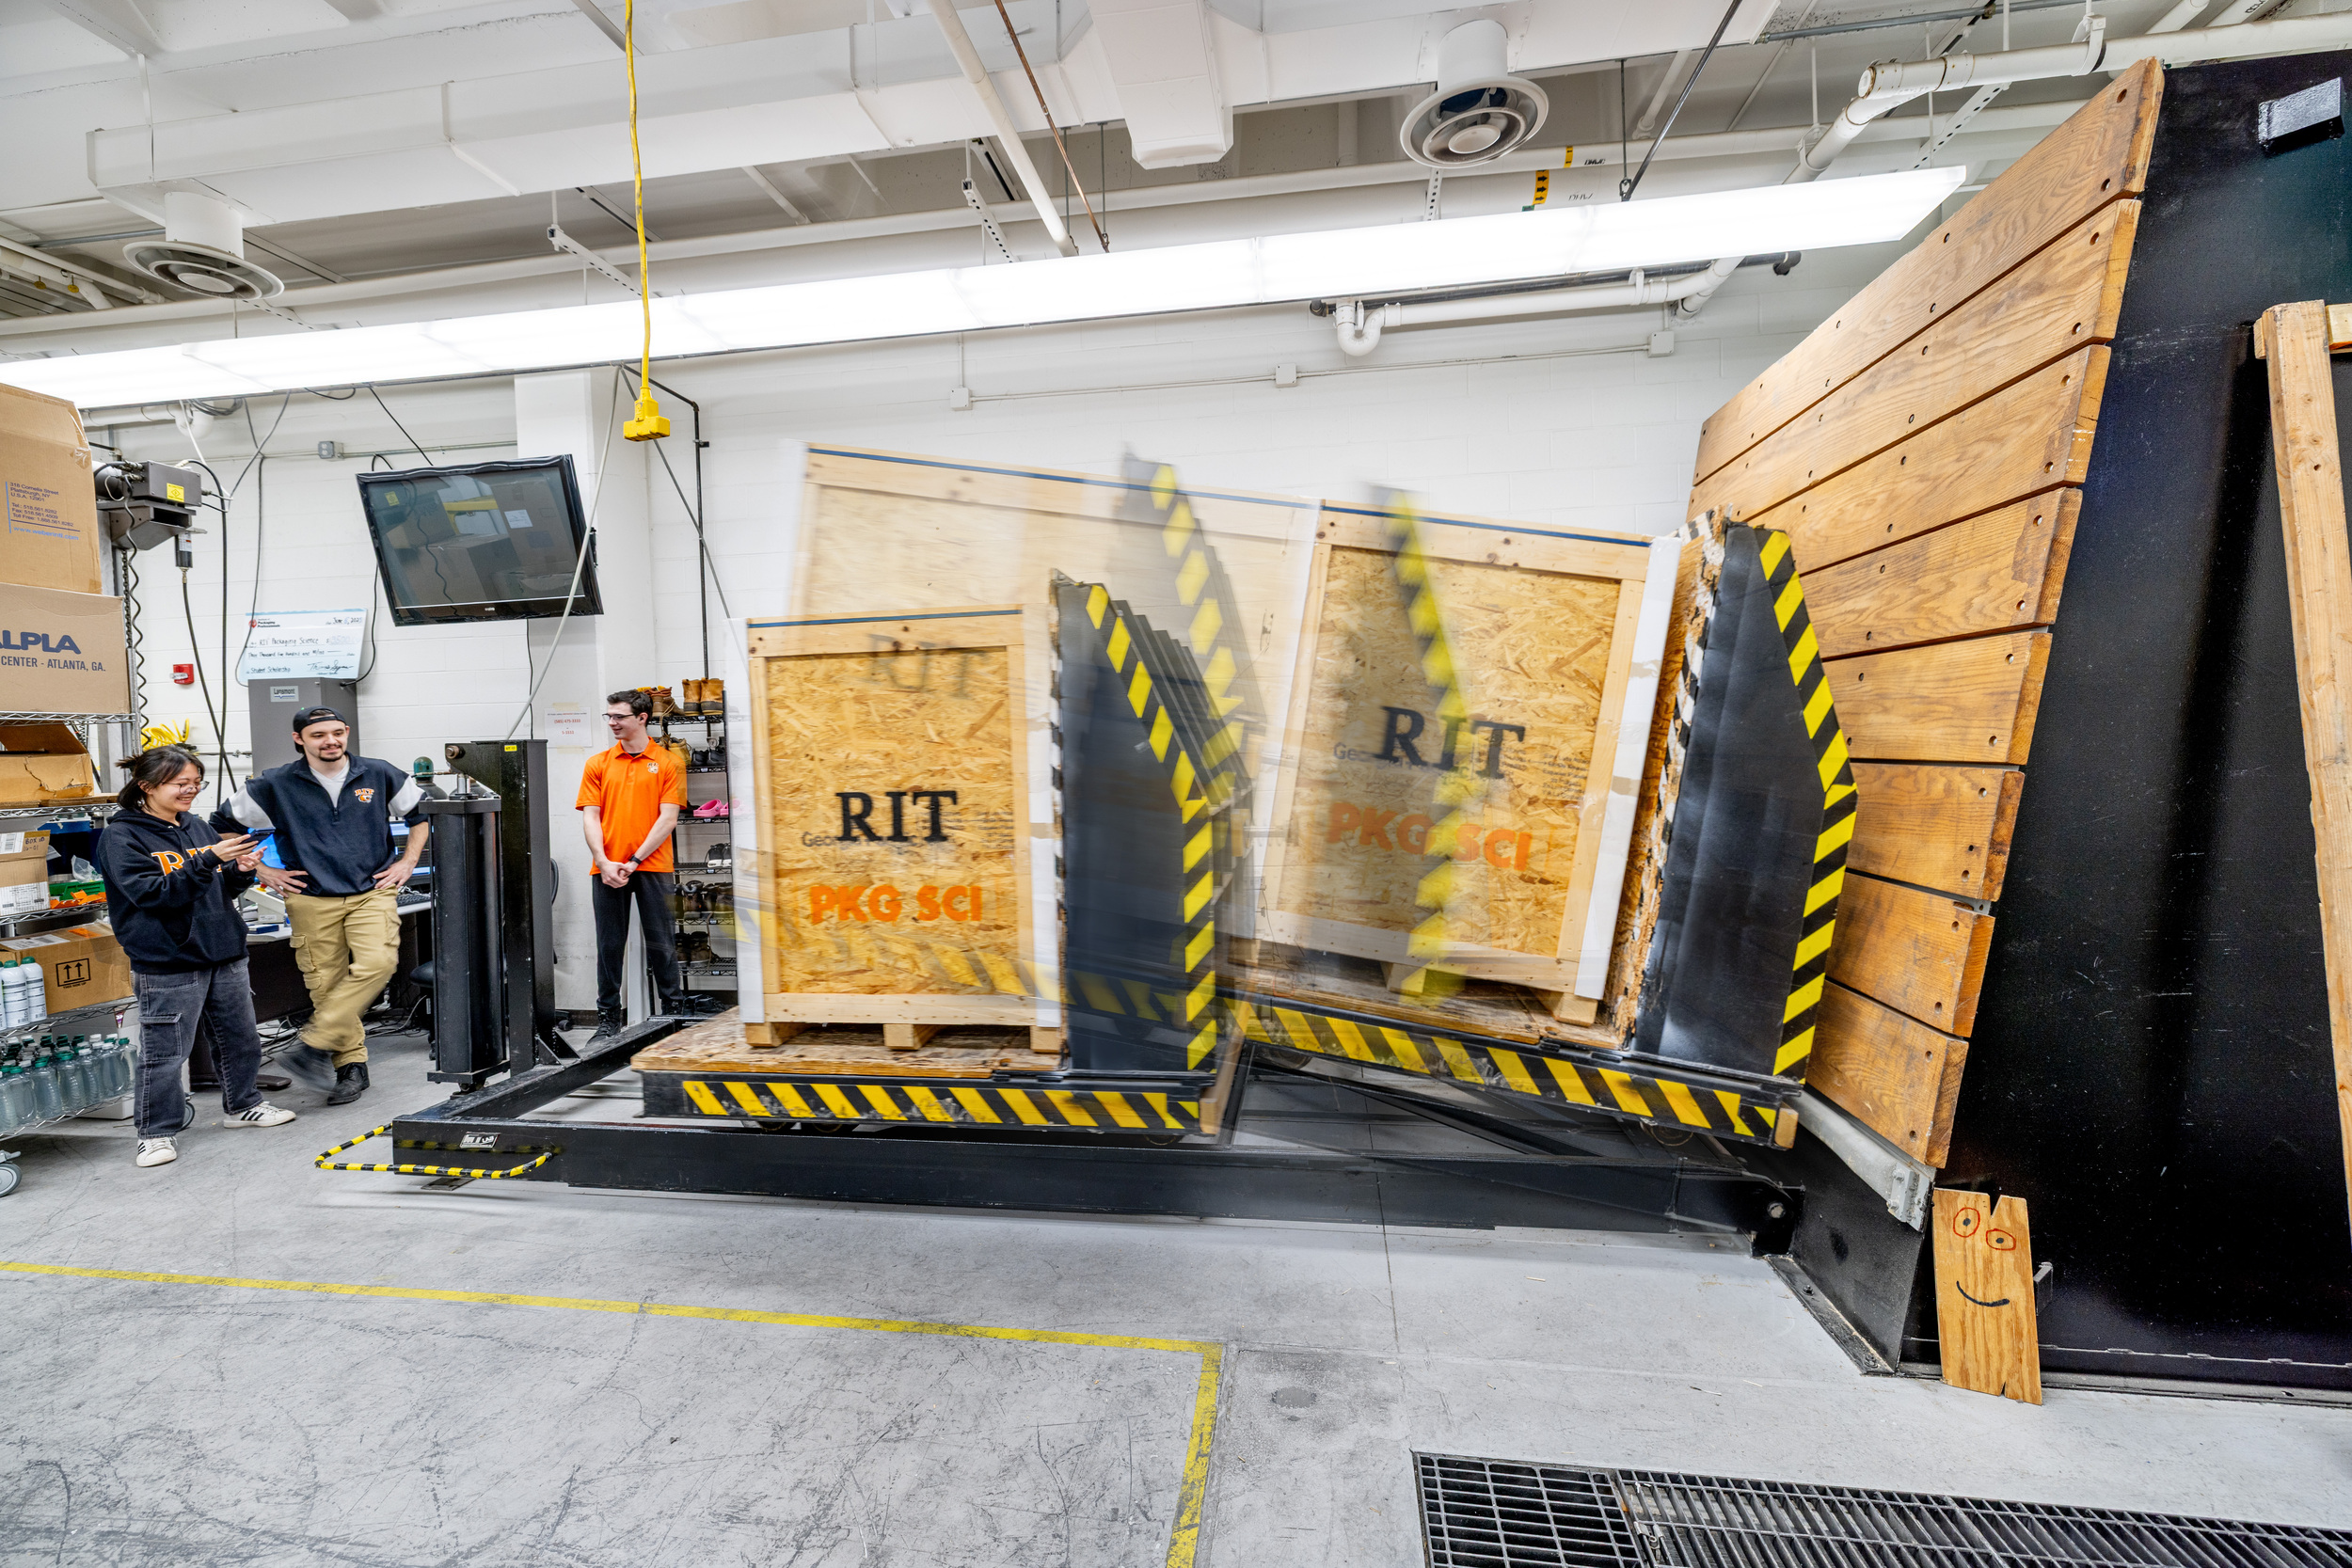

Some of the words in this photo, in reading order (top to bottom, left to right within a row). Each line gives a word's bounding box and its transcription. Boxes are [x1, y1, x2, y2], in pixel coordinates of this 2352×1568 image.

[1, 656, 38, 667] CENTER
[47, 659, 89, 672] ATLANTA,
[92, 662, 106, 671] GA.
[835, 791, 957, 842] RIT
[1452, 824, 1533, 872] SCI
[810, 885, 902, 925] PKG
[916, 885, 983, 922] SCI
